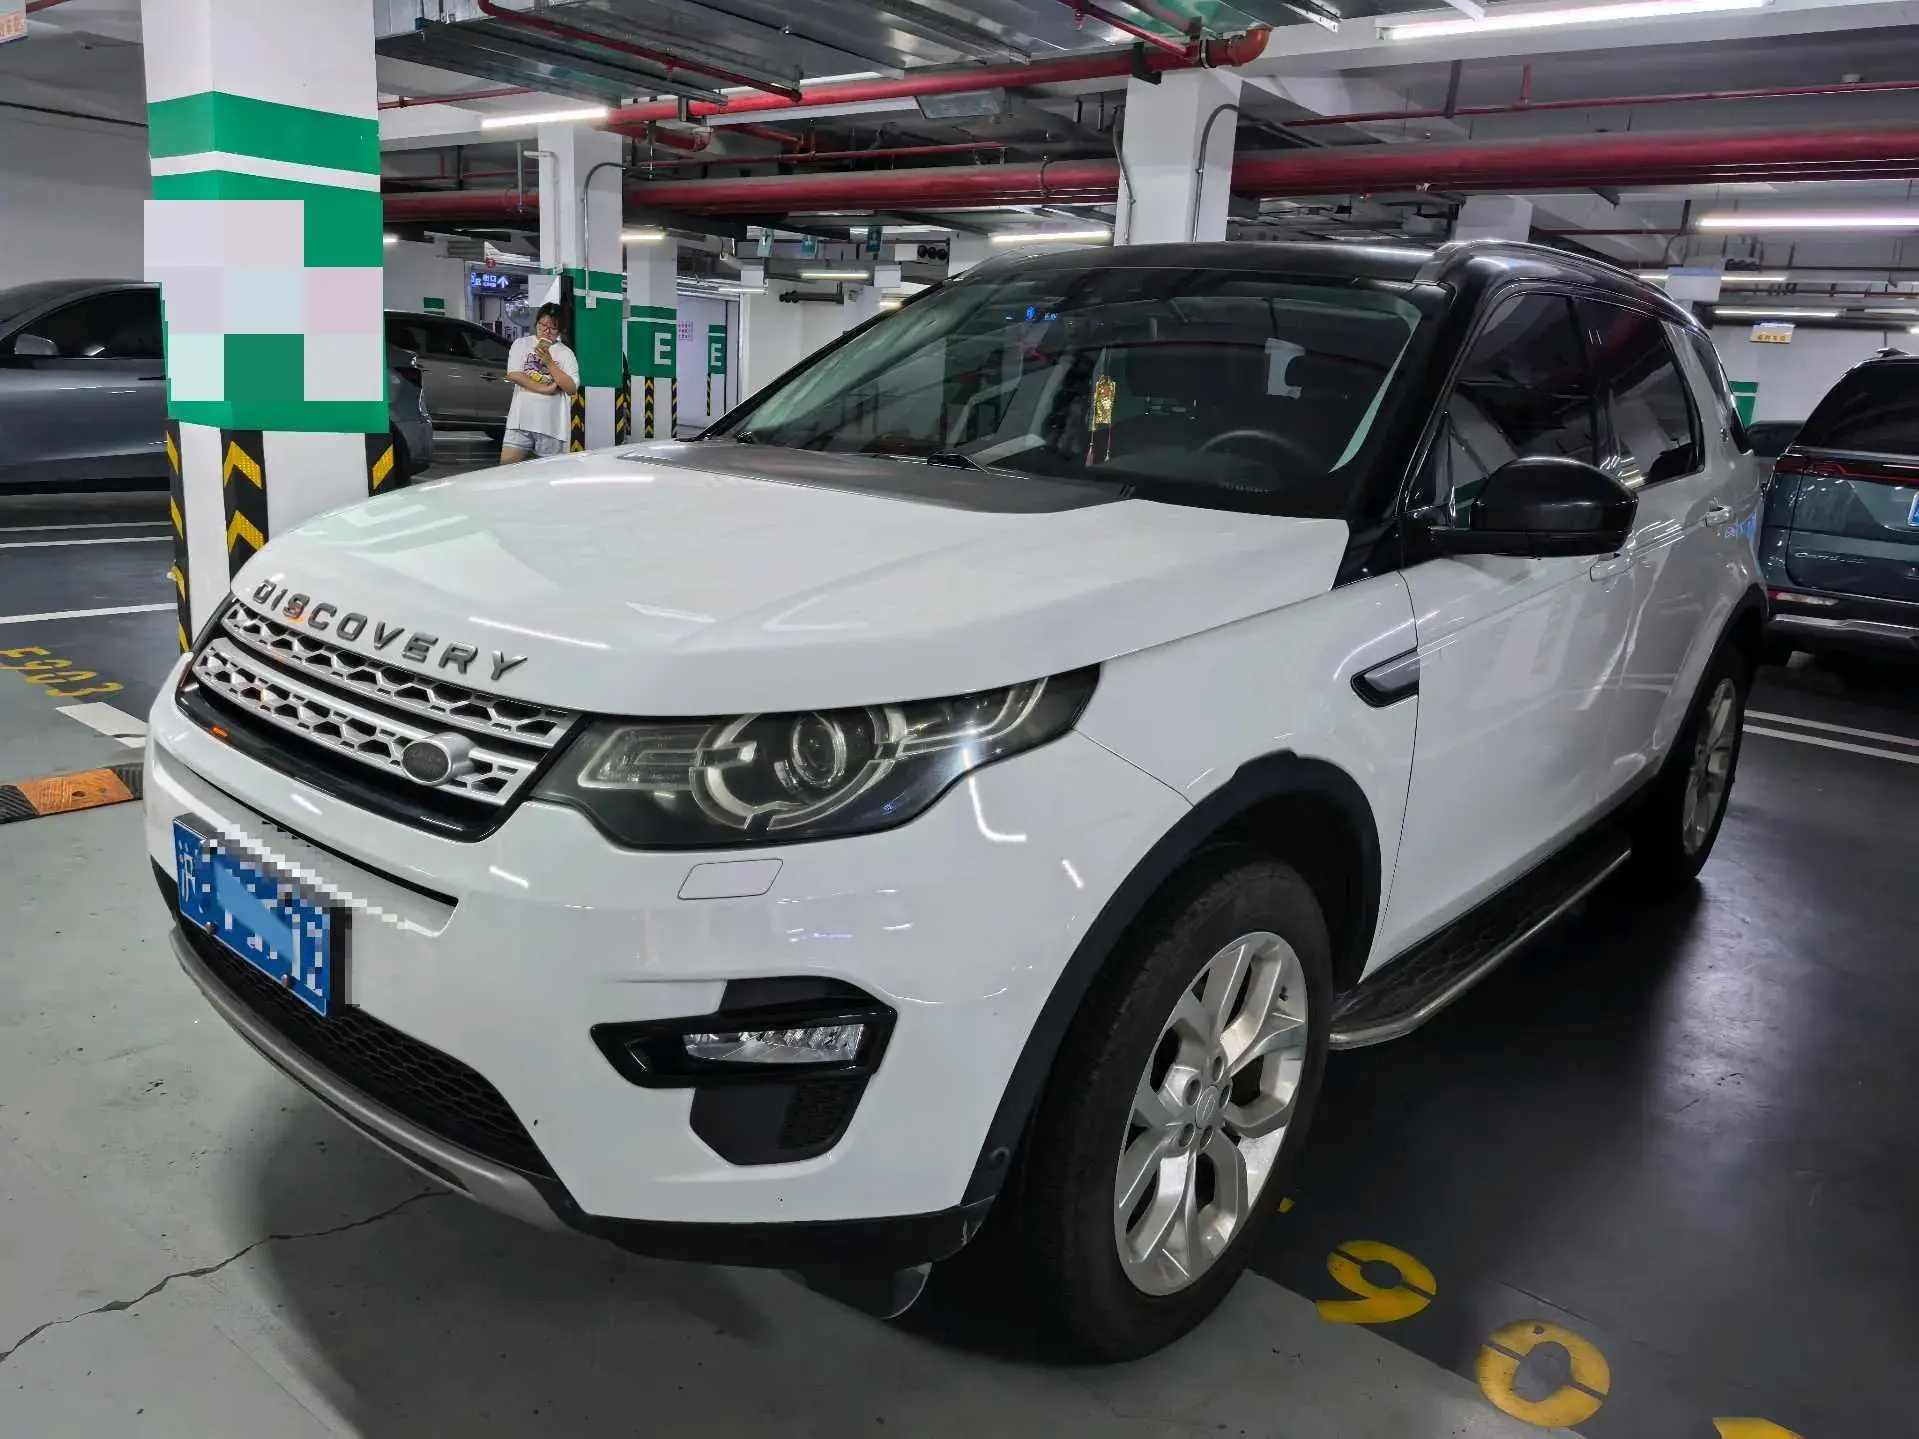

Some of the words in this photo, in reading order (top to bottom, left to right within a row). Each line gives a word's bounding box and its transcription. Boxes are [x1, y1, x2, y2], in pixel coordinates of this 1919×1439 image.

[654, 332, 672, 365] E
[710, 343, 722, 366] E
[252, 579, 528, 681] DISCOVERY
